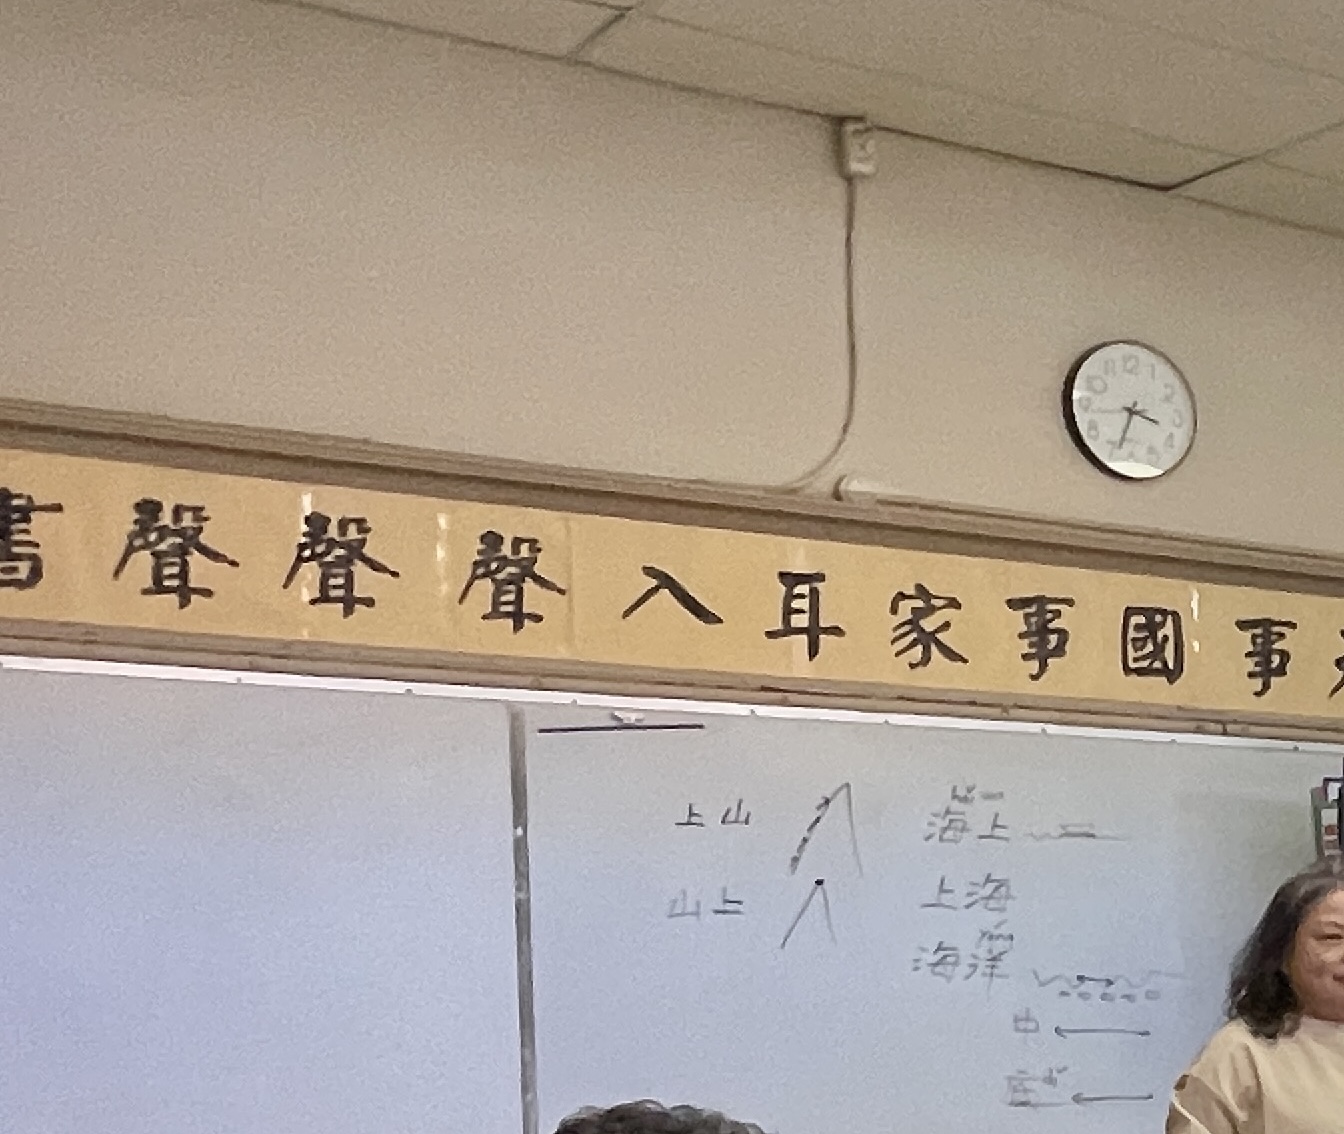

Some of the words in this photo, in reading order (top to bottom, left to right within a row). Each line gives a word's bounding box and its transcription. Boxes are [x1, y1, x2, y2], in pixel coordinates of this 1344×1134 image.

[675, 799, 750, 827] 上山
[924, 806, 1010, 844] 海上
[667, 887, 744, 919] 山上
[920, 873, 1016, 912] 上海
